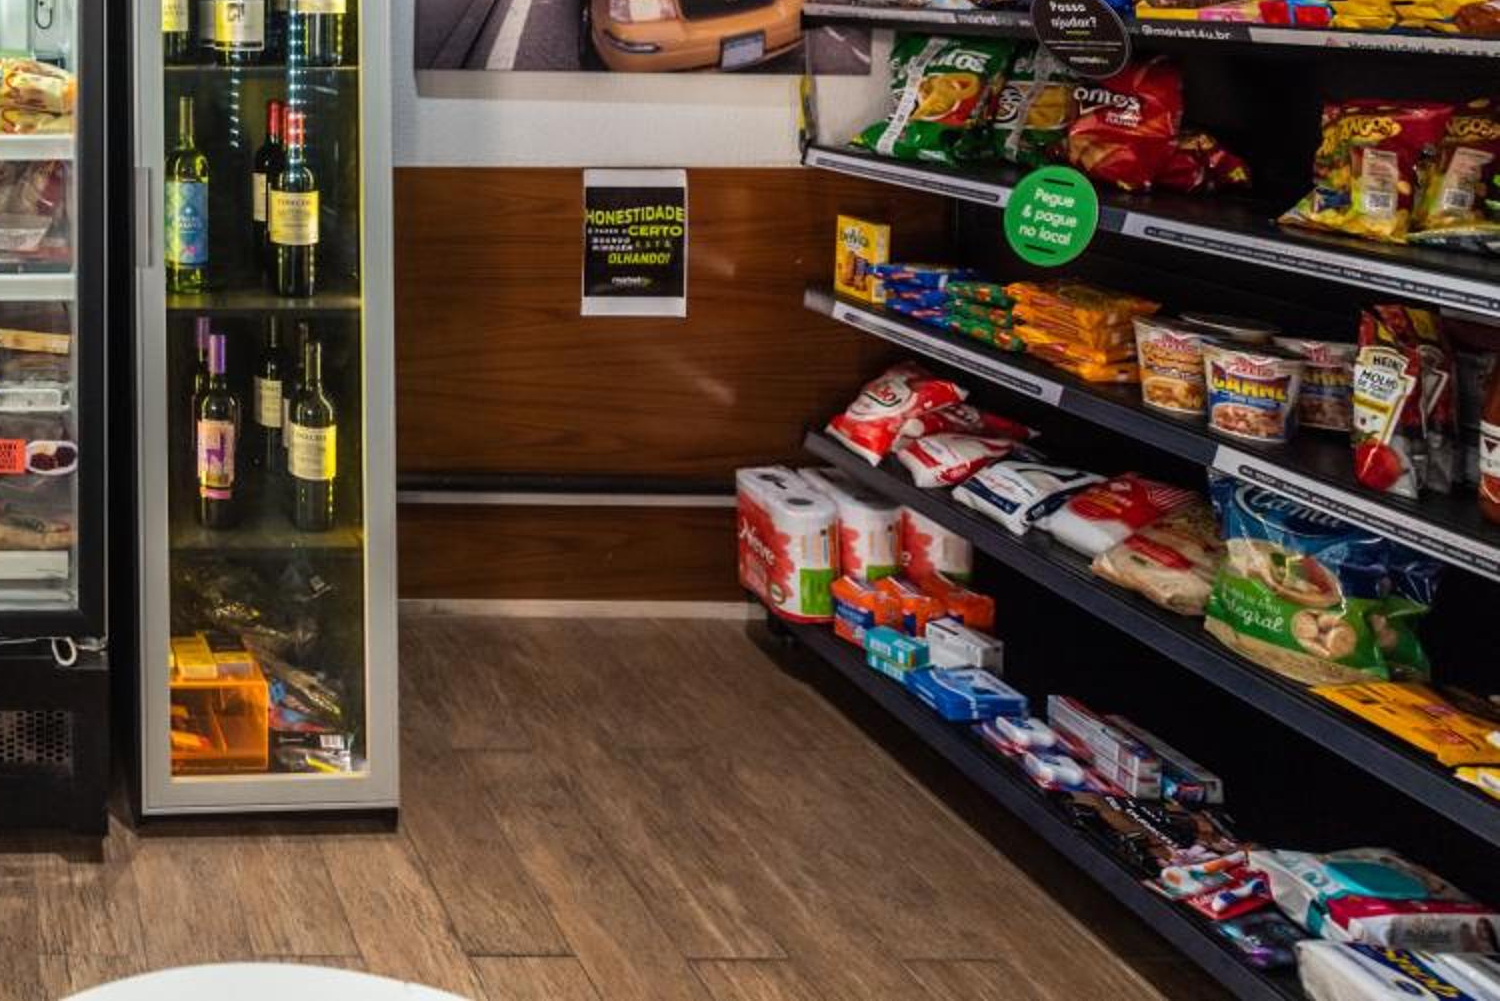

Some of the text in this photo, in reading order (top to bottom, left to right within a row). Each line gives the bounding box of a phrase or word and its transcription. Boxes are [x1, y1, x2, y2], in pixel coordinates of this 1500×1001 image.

[1034, 187, 1076, 208] Pegue
[584, 204, 685, 227] HONESTIDADE
[1033, 209, 1078, 228] pague
[627, 224, 684, 238] CERTO
[1018, 224, 1073, 246] no local
[607, 251, 671, 265] OLHANDO!
